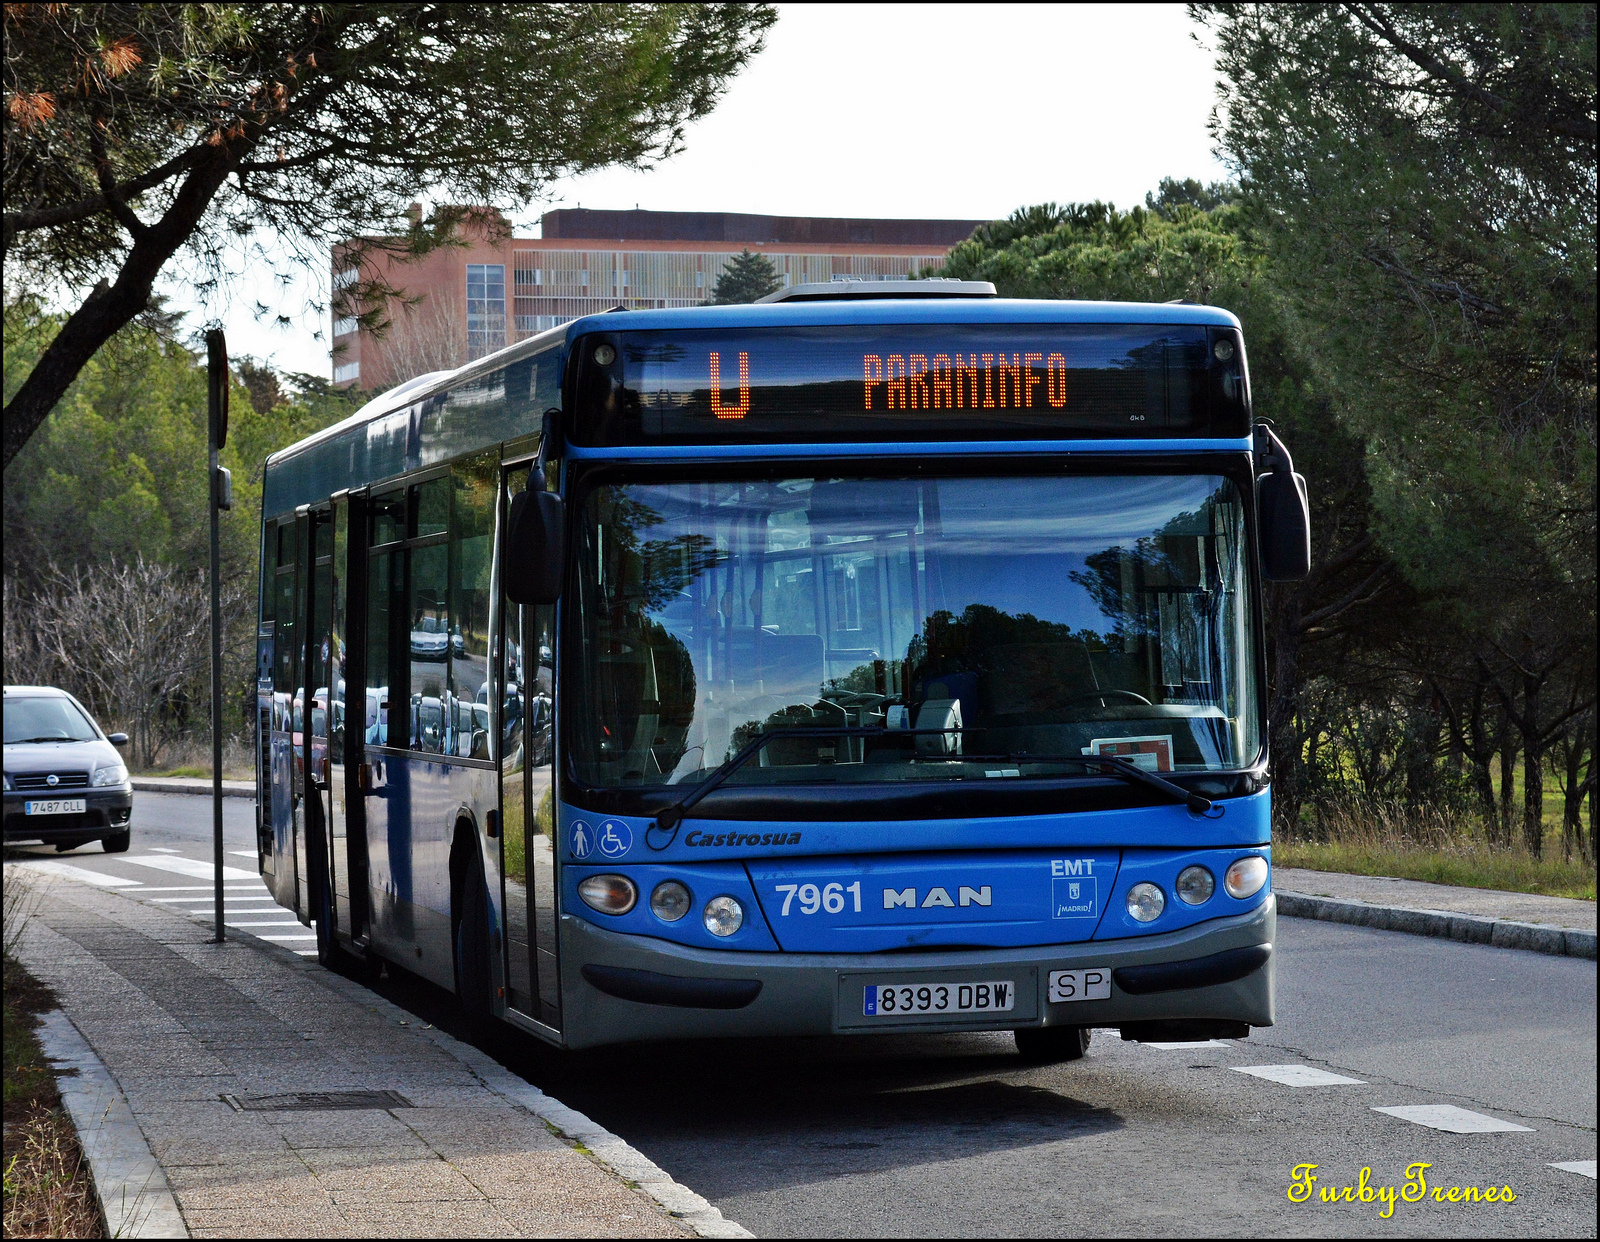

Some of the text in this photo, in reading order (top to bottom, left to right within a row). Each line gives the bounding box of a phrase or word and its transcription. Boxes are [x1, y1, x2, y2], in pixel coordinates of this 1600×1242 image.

[709, 351, 1067, 420] U PARANINFO
[32, 801, 83, 813] 7487 CLL
[684, 830, 802, 847] Castrosua
[1050, 858, 1096, 877] EMT
[775, 881, 862, 916] 7961
[883, 885, 992, 909] MAN
[881, 986, 949, 1012] 8393
[958, 983, 1008, 1010] DBW
